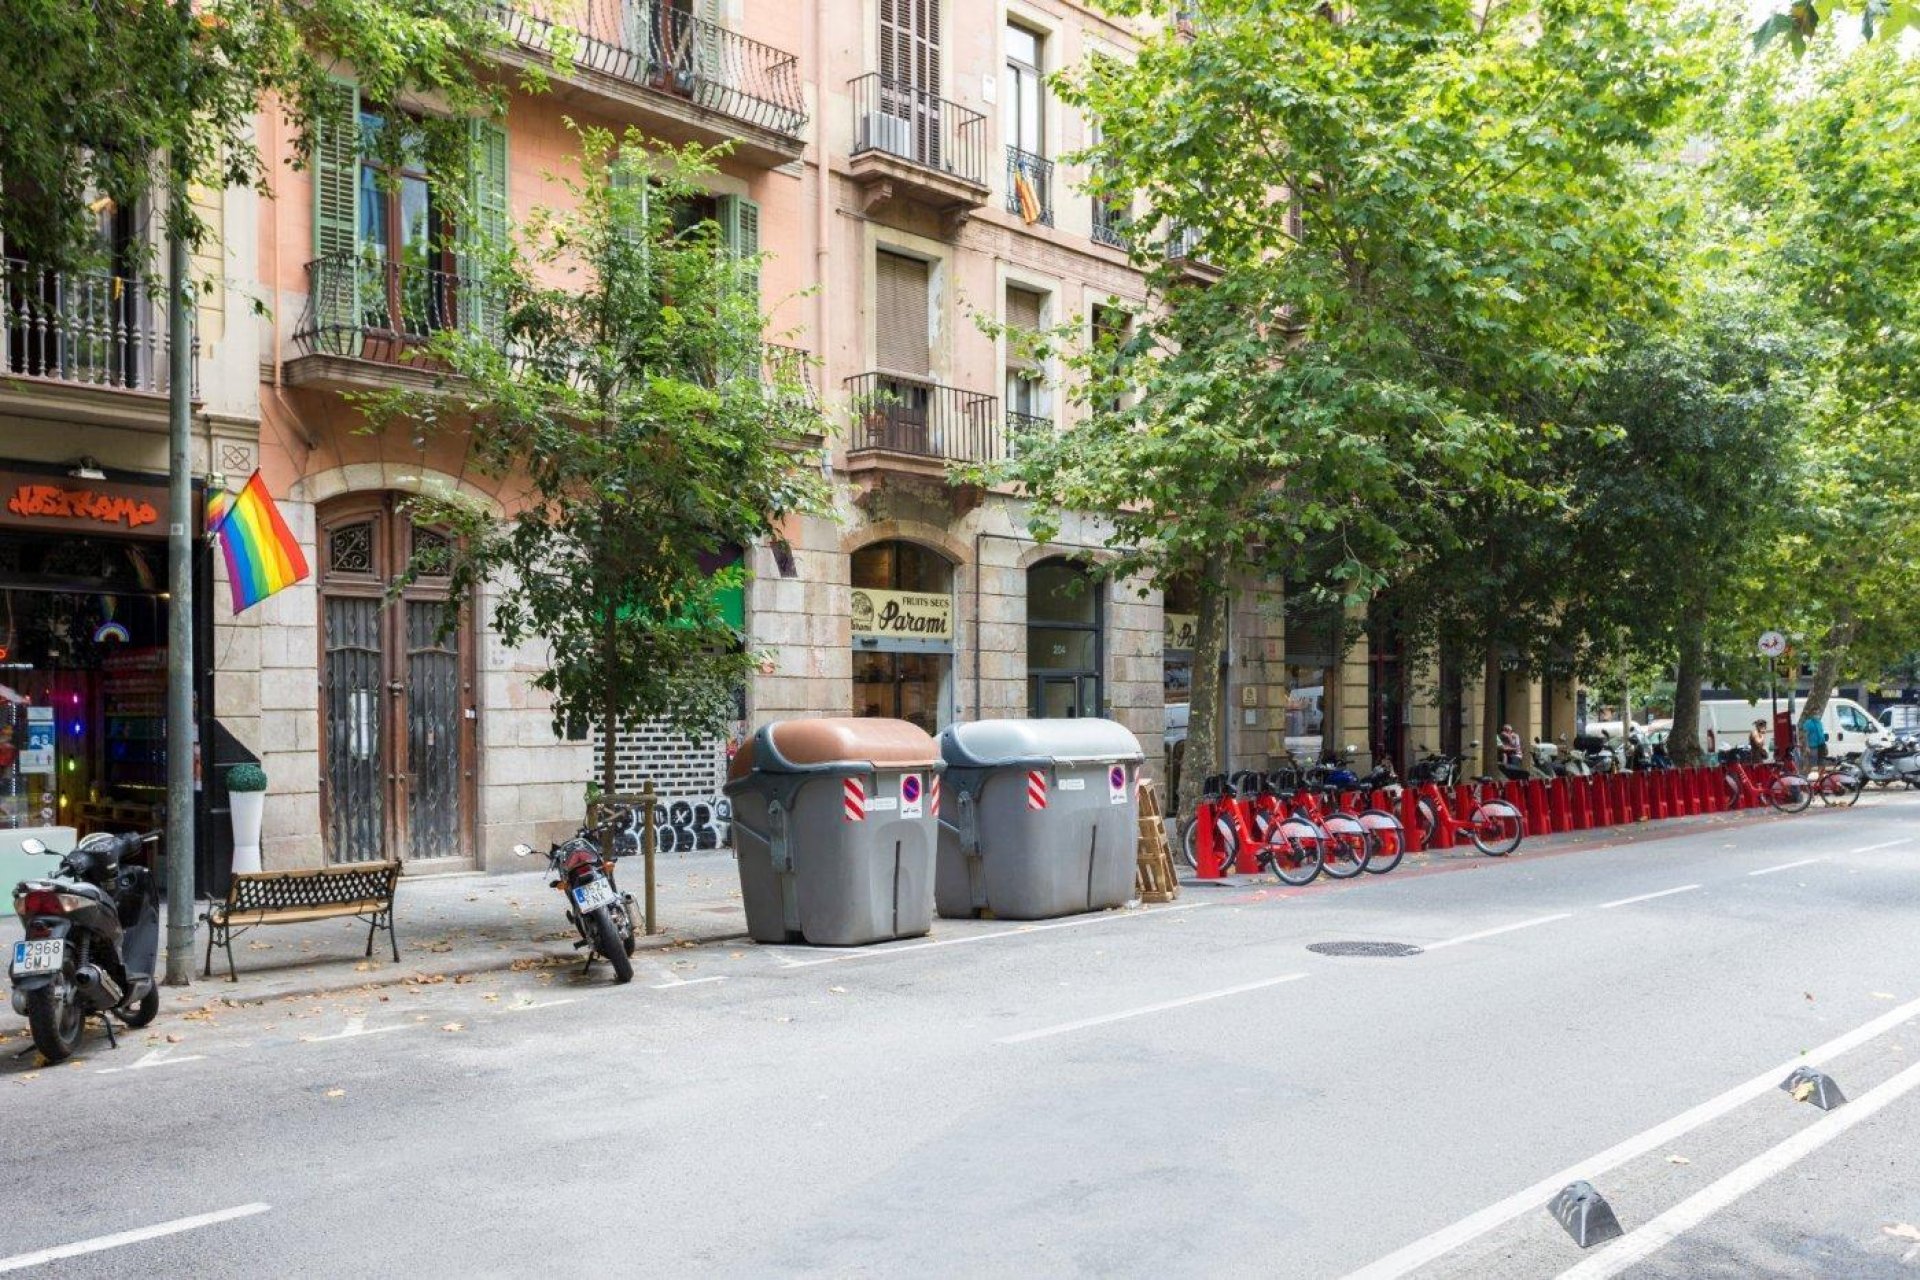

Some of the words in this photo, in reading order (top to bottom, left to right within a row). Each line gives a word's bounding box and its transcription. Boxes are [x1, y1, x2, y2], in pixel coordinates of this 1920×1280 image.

[902, 597, 928, 606] FRUITS
[930, 598, 949, 608] SECS
[878, 600, 947, 633] Parami
[26, 941, 60, 956] 2968
[25, 955, 50, 969] GMJ
